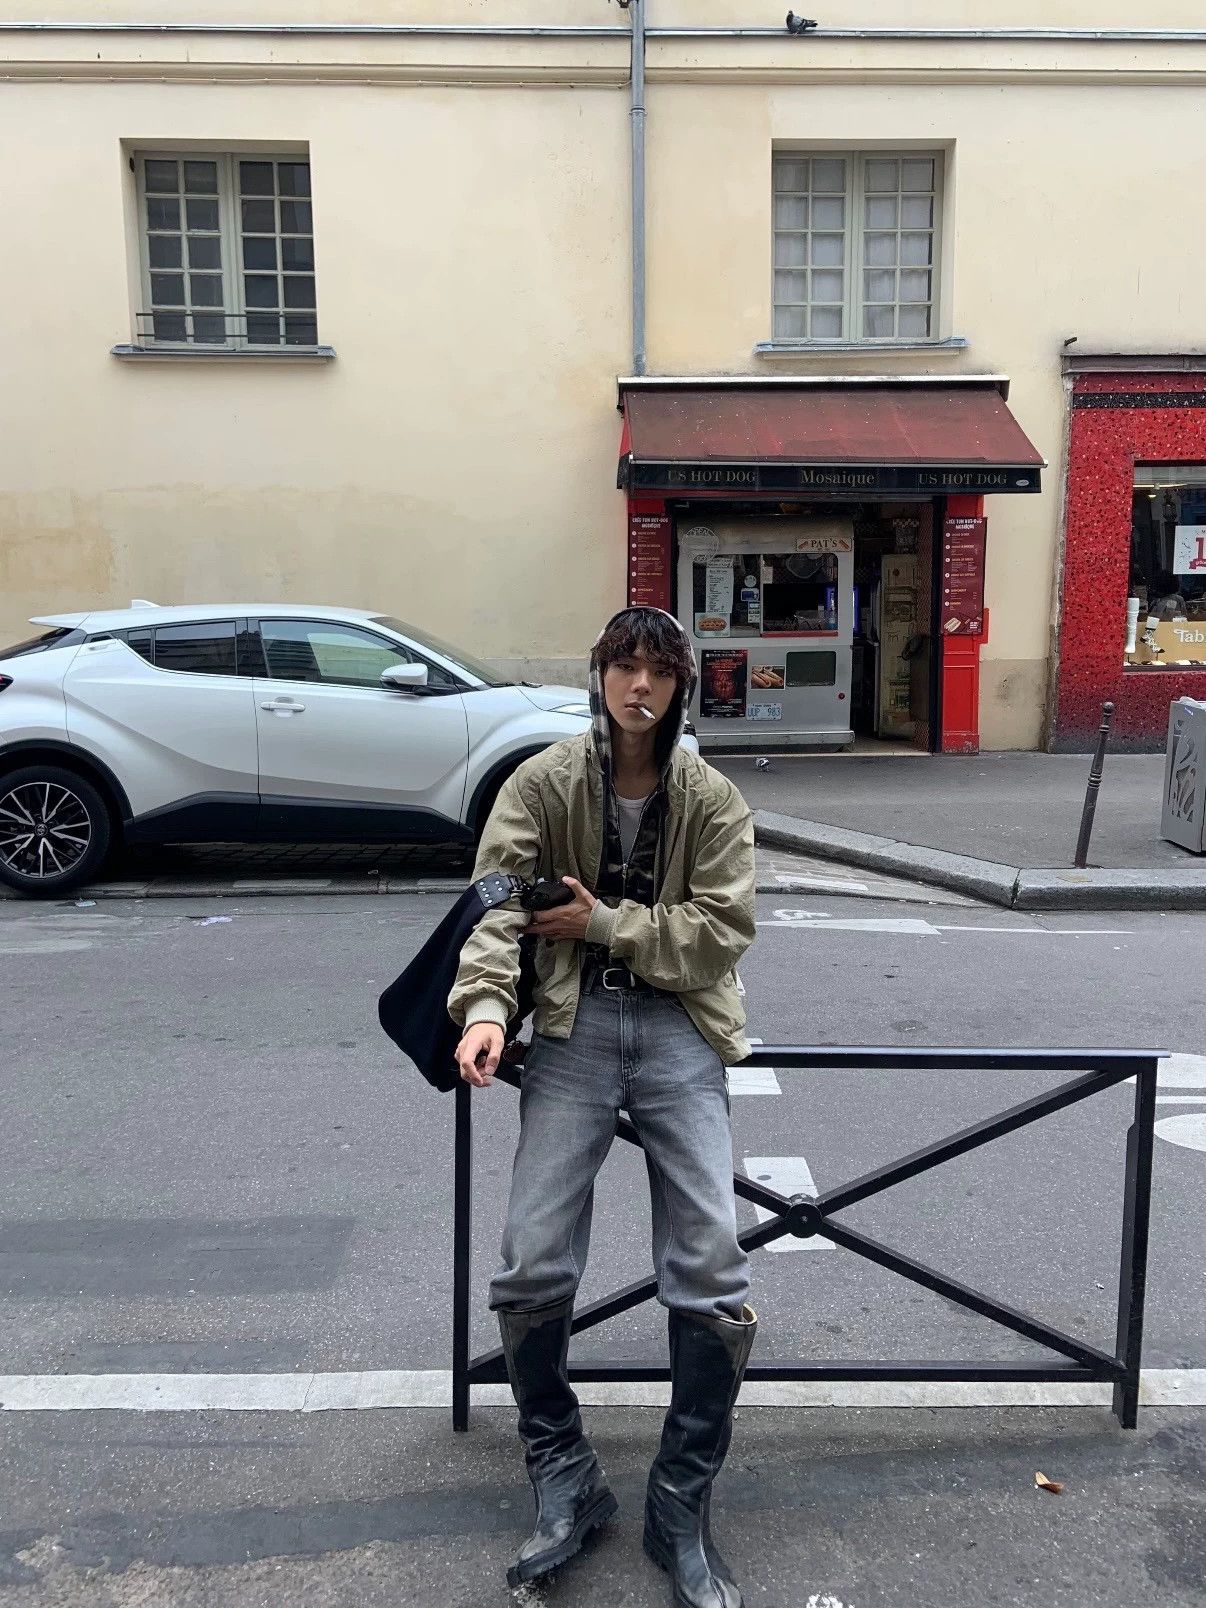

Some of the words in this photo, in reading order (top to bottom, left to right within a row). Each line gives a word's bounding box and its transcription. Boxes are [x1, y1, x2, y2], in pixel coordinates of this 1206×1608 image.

[667, 470, 687, 482] US
[690, 470, 723, 482] HOT
[726, 471, 757, 483] DOG
[919, 473, 938, 484] US
[941, 473, 973, 485] HOT
[976, 473, 1008, 485] DOG
[810, 538, 838, 548] PAT'S
[1173, 629, 1206, 643] Tab
